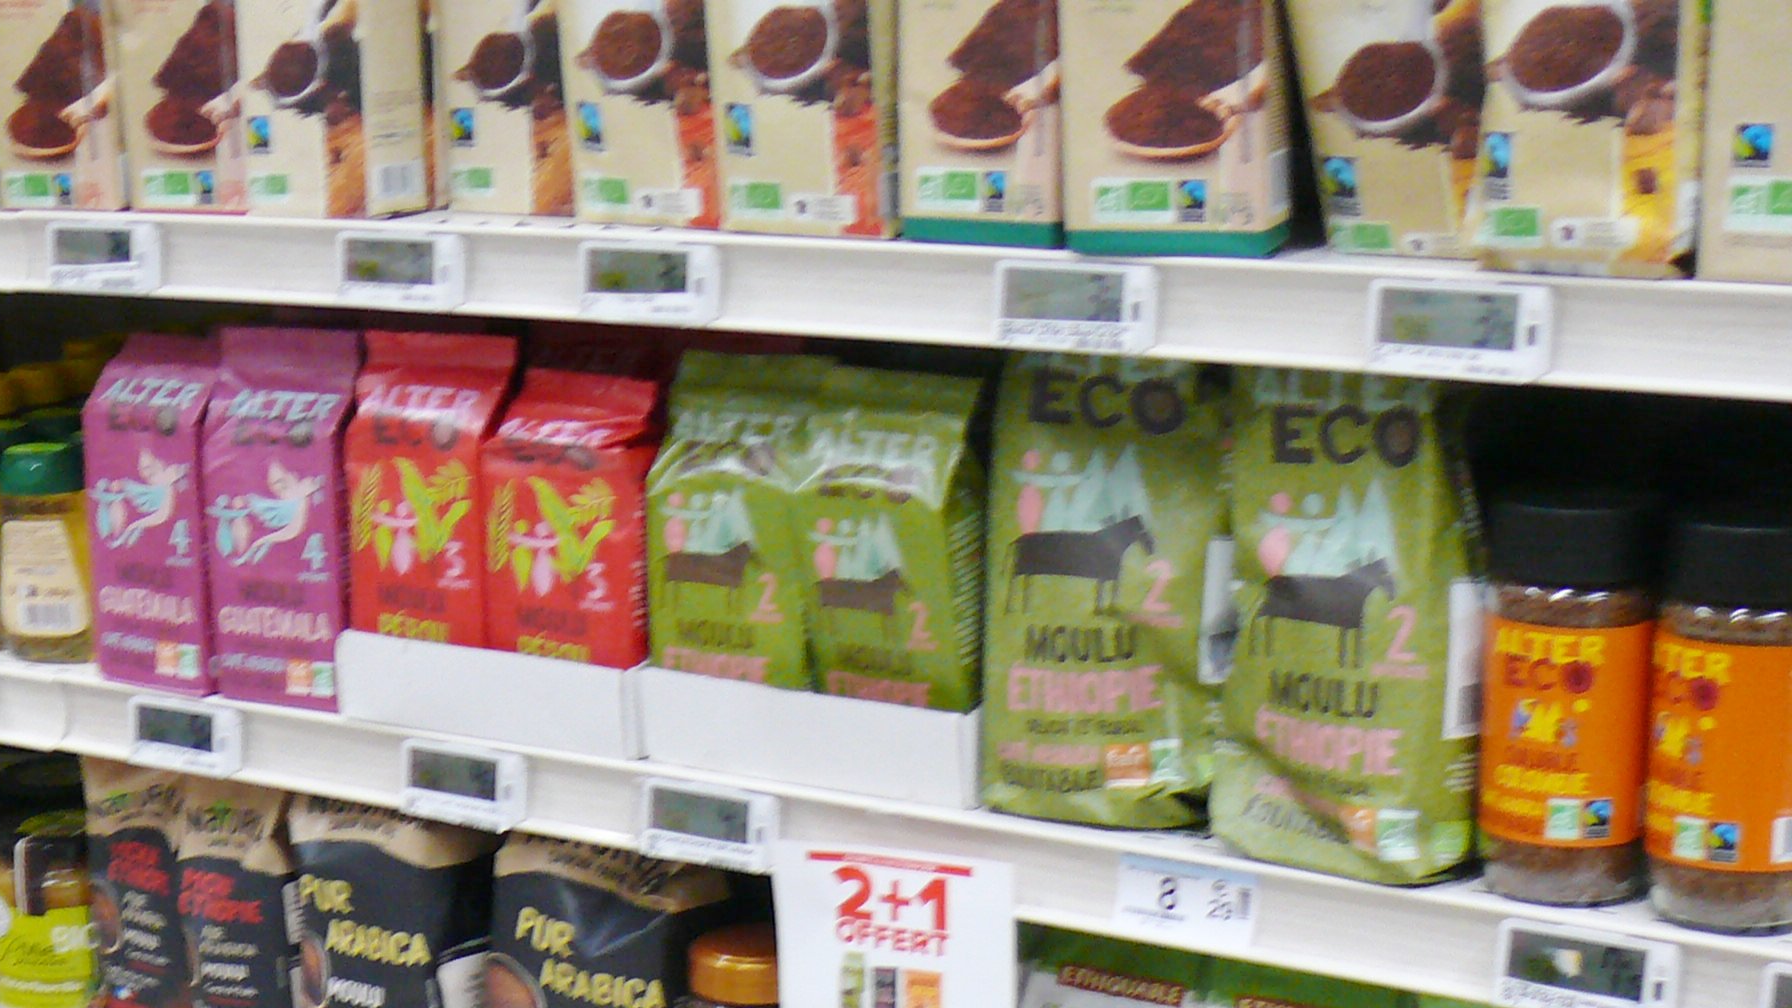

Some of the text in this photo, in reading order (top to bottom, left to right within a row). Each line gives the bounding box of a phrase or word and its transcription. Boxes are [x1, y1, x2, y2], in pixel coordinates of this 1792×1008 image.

[98, 377, 205, 410] ALTER
[226, 387, 344, 423] ALTER
[357, 383, 481, 421] ALTER
[1030, 366, 1187, 436] ECO
[1270, 402, 1422, 468] ECO
[168, 519, 192, 556] 4
[301, 531, 328, 570] 4
[442, 540, 466, 577] 3
[584, 562, 610, 599] 3
[757, 572, 780, 612] 2
[1141, 557, 1174, 613] 2
[1022, 621, 1140, 664] MOULU
[1382, 604, 1417, 662] 2
[1495, 626, 1606, 667] ALTER
[1505, 654, 1595, 694] ECO
[1652, 642, 1733, 685] TER
[1268, 668, 1379, 719] MOULU
[830, 864, 950, 933] 2+1
[1157, 875, 1179, 912] 8
[324, 918, 432, 967] ARABICA
[514, 906, 577, 959] PUR
[836, 915, 951, 958] OFFERT
